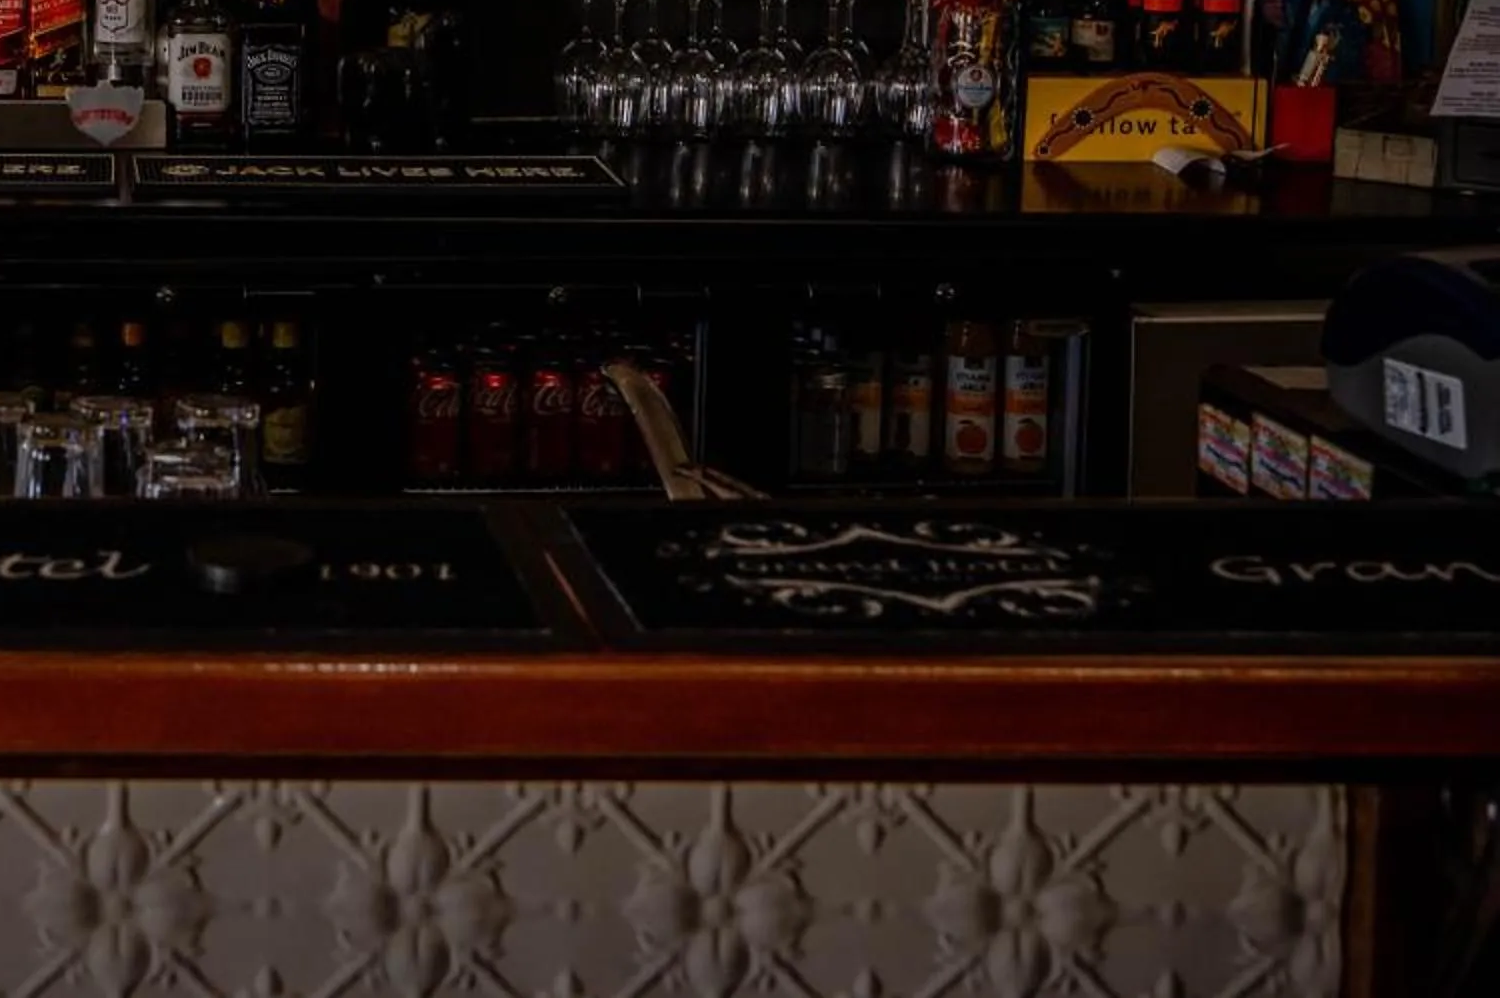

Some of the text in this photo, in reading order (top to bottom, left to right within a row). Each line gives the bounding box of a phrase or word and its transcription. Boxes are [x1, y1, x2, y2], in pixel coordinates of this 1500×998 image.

[215, 164, 325, 179] JACK
[337, 164, 455, 179] LIVES
[317, 558, 458, 583] 1901
